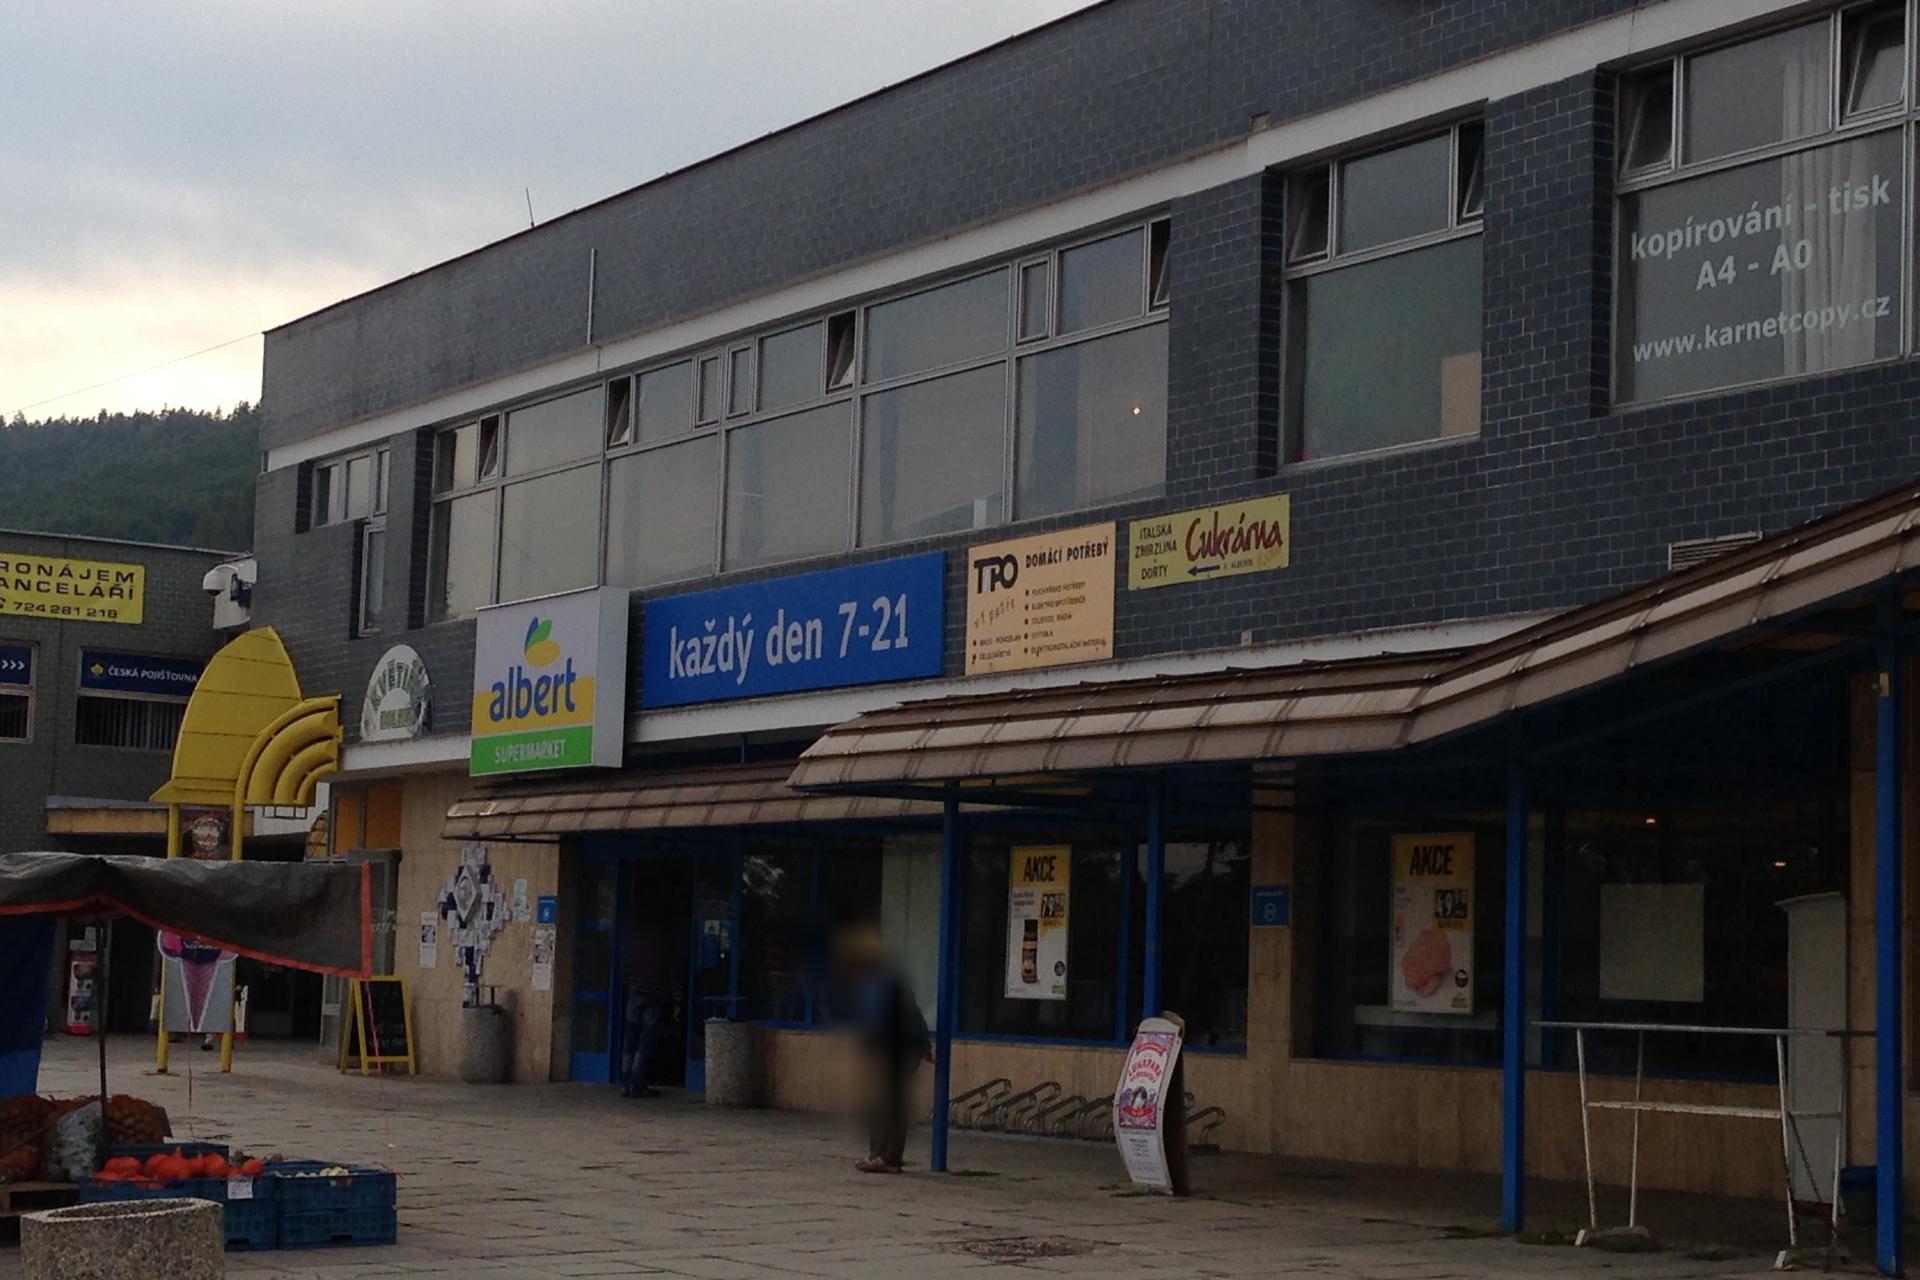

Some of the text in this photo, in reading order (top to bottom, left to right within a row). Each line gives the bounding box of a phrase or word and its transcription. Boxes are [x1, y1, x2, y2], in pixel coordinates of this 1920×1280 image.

[1631, 193, 1792, 260] kopírování
[1828, 174, 1890, 215] tisk
[1696, 255, 1737, 291] A4
[1770, 239, 1813, 276] A0
[1633, 296, 1890, 362] www.karnetcopy.cz
[1135, 540, 1177, 559] ZMRZLINA
[1185, 511, 1283, 562] Cukrárna
[1141, 564, 1168, 580] DORTY
[13, 601, 118, 619] 724 281 218
[669, 593, 908, 686] každý den 7-21
[108, 665, 139, 678] ČESKÁ
[489, 657, 577, 722] albert
[495, 739, 567, 764] SUPERMARKET
[1023, 855, 1057, 882] AKCE
[1409, 845, 1455, 876] AKCE
